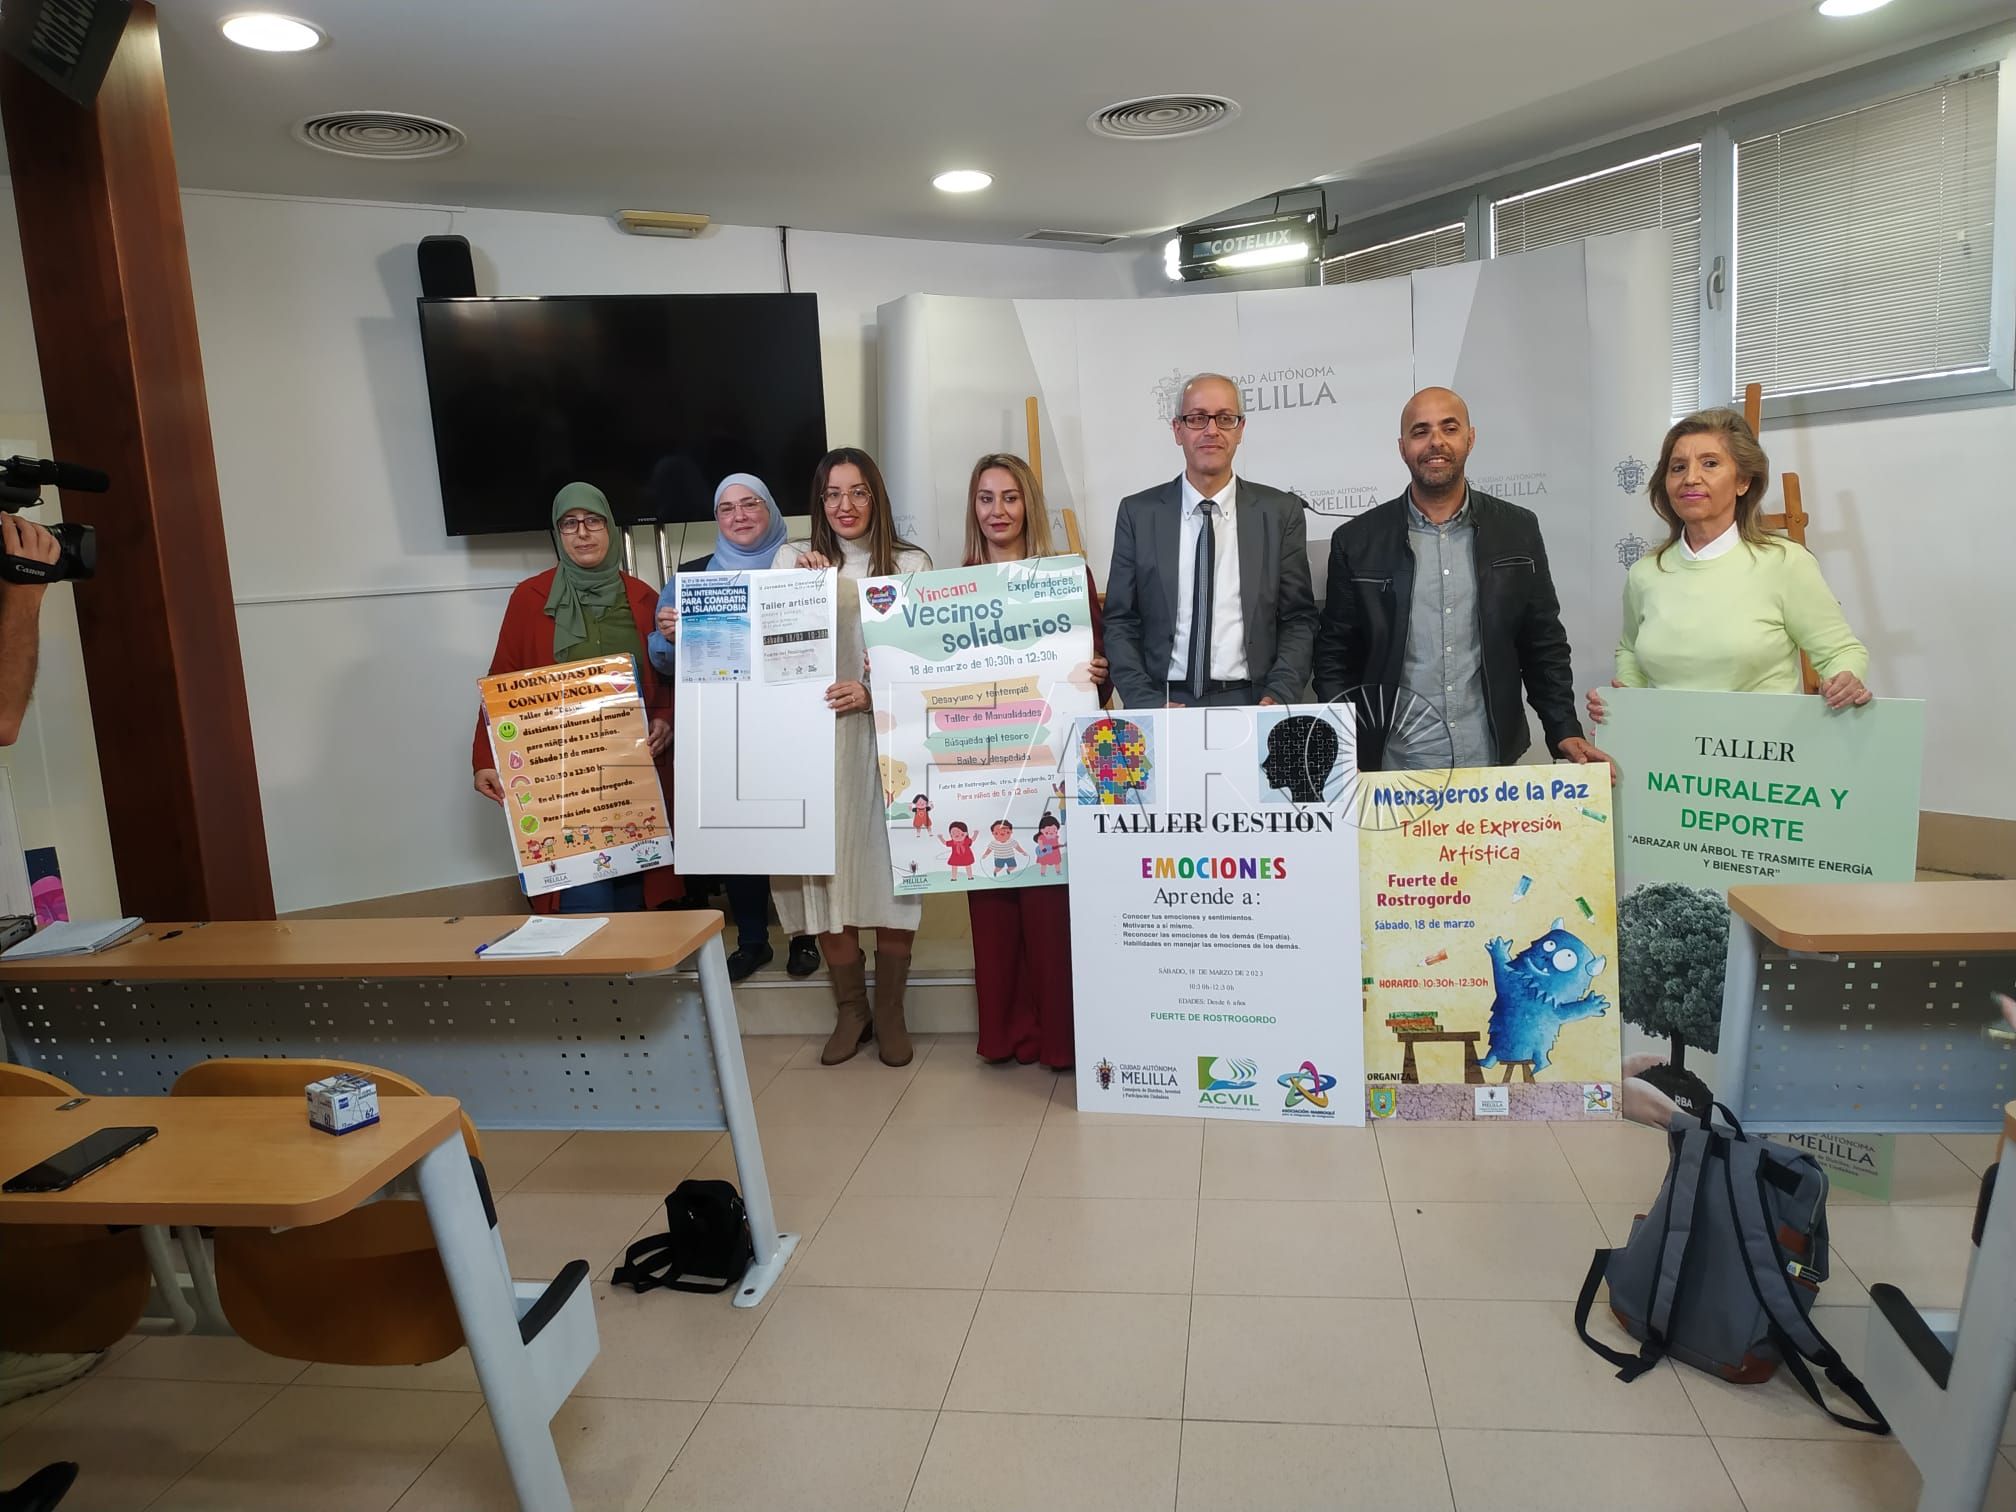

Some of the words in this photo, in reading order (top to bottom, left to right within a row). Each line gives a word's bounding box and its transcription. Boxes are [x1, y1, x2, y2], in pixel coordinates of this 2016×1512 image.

[1211, 229, 1291, 254] COTELUX
[1260, 364, 1336, 383] AUTÓNOMA
[1241, 381, 1337, 413] ELILLA
[1480, 481, 1548, 498] MELILLA
[1311, 494, 1379, 511] MELILLA
[16, 564, 46, 577] Canon
[694, 587, 747, 597] INTERNACIONAL
[915, 581, 978, 604] Yincana
[1007, 575, 1074, 593] Exploradores
[1034, 588, 1047, 599] en
[1049, 581, 1083, 597] Acción
[681, 597, 702, 606] PARA
[704, 595, 747, 604] COMBATIR
[681, 606, 691, 614] LA
[692, 603, 747, 613] ISLAMOFOBIA
[760, 602, 786, 611] Taller
[901, 598, 1004, 629] Vecinos
[942, 613, 1072, 653] solidarios
[910, 665, 920, 676] 18
[922, 663, 934, 674] de
[936, 661, 968, 672] marzo
[970, 657, 982, 669] de
[985, 655, 1015, 669] 10:30h
[1017, 657, 1023, 665] a
[1025, 650, 1058, 664] 12:30h
[496, 682, 508, 693] II
[510, 669, 586, 691] JORNADAS
[589, 665, 607, 677] DE
[508, 683, 603, 709] CONVIVENCIA
[931, 691, 974, 706] Desayuno
[976, 692, 983, 700] y
[519, 711, 541, 721] Taller
[544, 708, 554, 716] de
[944, 711, 970, 723] Taller
[973, 711, 983, 721] de
[985, 708, 1042, 721] Manualidades
[523, 724, 559, 736] distintas
[560, 718, 590, 729] culturas
[591, 714, 603, 723] del
[526, 743, 543, 754] para
[569, 735, 578, 743] de
[944, 735, 984, 748] Búsqueda
[986, 732, 998, 744] del
[1000, 732, 1029, 743] tesoro
[529, 753, 559, 766] Sábado
[570, 749, 580, 757] de
[1695, 736, 1796, 762] TALLER
[957, 755, 978, 766] Baile
[980, 756, 986, 766] y
[989, 752, 1031, 765] despedida
[538, 796, 548, 804] En
[548, 794, 555, 802] el
[556, 791, 579, 799] Fuerte
[581, 787, 590, 795] de
[1373, 783, 1489, 811] Mensajeros
[1495, 781, 1520, 802] de
[1526, 781, 1545, 801] la
[1551, 779, 1590, 800] Paz
[1647, 771, 1821, 808] NATURALEZA
[1830, 788, 1849, 810] Y
[543, 814, 559, 823] Para
[1093, 811, 1210, 834] TALLER
[1211, 805, 1335, 834] GESTIÓN
[1400, 819, 1450, 838] Taller
[1455, 819, 1475, 835] de
[1480, 814, 1562, 837] Expresión
[1681, 808, 1804, 842] DEPORTE
[1439, 845, 1520, 866] Artística
[1683, 842, 1698, 853] UN
[1700, 842, 1738, 858] ÁRBOL
[1741, 849, 1755, 860] TE
[1757, 851, 1816, 869] TRASMITE
[1818, 858, 1873, 876] ENERGÍA
[1703, 859, 1711, 869] Y
[1141, 856, 1288, 880] EMOCIONES
[1387, 873, 1437, 888] Fuerte
[1440, 872, 1458, 887] de
[1153, 887, 1234, 907] Aprende
[1242, 891, 1262, 905] a:
[1376, 890, 1471, 909] Rostrogordo
[1122, 912, 1150, 920] Conocer
[1151, 912, 1163, 920] tus
[1164, 913, 1201, 921] emociones
[1202, 914, 1207, 922] y
[1208, 913, 1254, 922] sentimientos.
[1374, 920, 1412, 931] Sábado,
[1414, 920, 1425, 930] 18
[1428, 919, 1441, 930] de
[1443, 920, 1475, 929] marzo
[1160, 931, 1170, 939] las
[1171, 931, 1208, 939] emociones
[1220, 932, 1230, 940] los
[1231, 932, 1255, 940] demás
[1173, 941, 1200, 949] manejar
[1202, 941, 1212, 949] las
[1263, 942, 1274, 950] los
[1209, 968, 1234, 976] MARZO
[1207, 998, 1226, 1006] Desde
[1150, 1011, 1186, 1021] FUERTE
[1188, 1013, 1201, 1022] DE
[1202, 1013, 1277, 1025] ROSTROGORDO
[1121, 1071, 1178, 1086] MELILLA
[1367, 1072, 1412, 1081] ORGANIZA
[1199, 1092, 1259, 1106] ACVIL
[1674, 1095, 1693, 1109] RBA
[365, 1107, 374, 1119] 62
[1788, 1133, 1875, 1167] MELILLA
